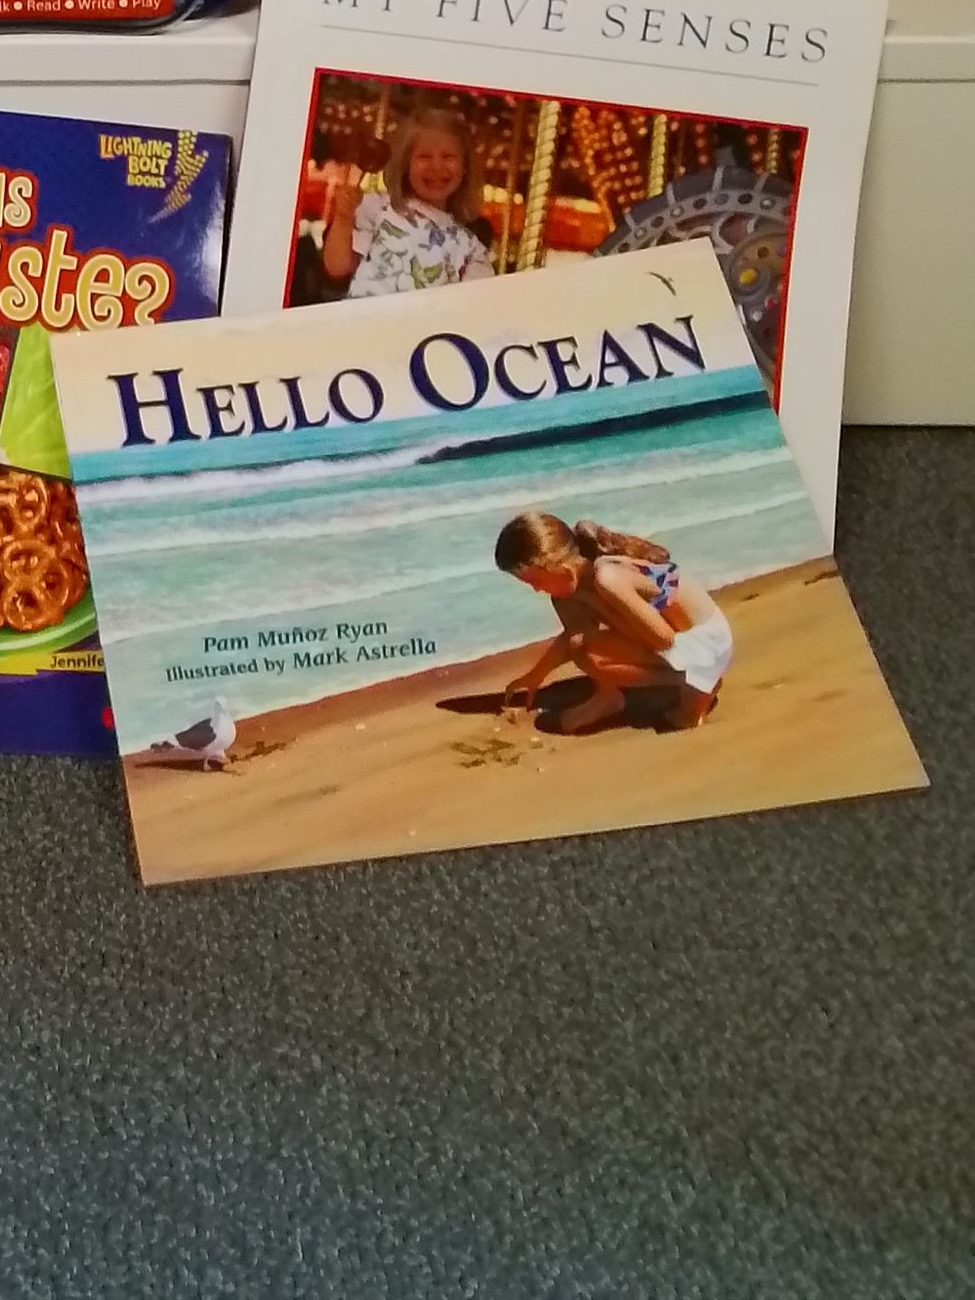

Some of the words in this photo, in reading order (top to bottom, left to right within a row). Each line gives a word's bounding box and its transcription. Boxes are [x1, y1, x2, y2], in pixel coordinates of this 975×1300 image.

[601, 4, 829, 64] SENSES
[99, 134, 172, 159] LIGHTNING
[127, 174, 166, 188] BOOKS
[128, 156, 167, 175] BOLT
[108, 368, 385, 448] HELLO
[408, 316, 707, 413] OCEAN
[204, 636, 249, 653] Pam
[258, 626, 328, 648] Muñoz
[336, 622, 389, 644] Ryan
[166, 658, 258, 682] Illustrated
[265, 656, 285, 675] by
[294, 647, 350, 669] Mark
[356, 637, 437, 662] Astrella
